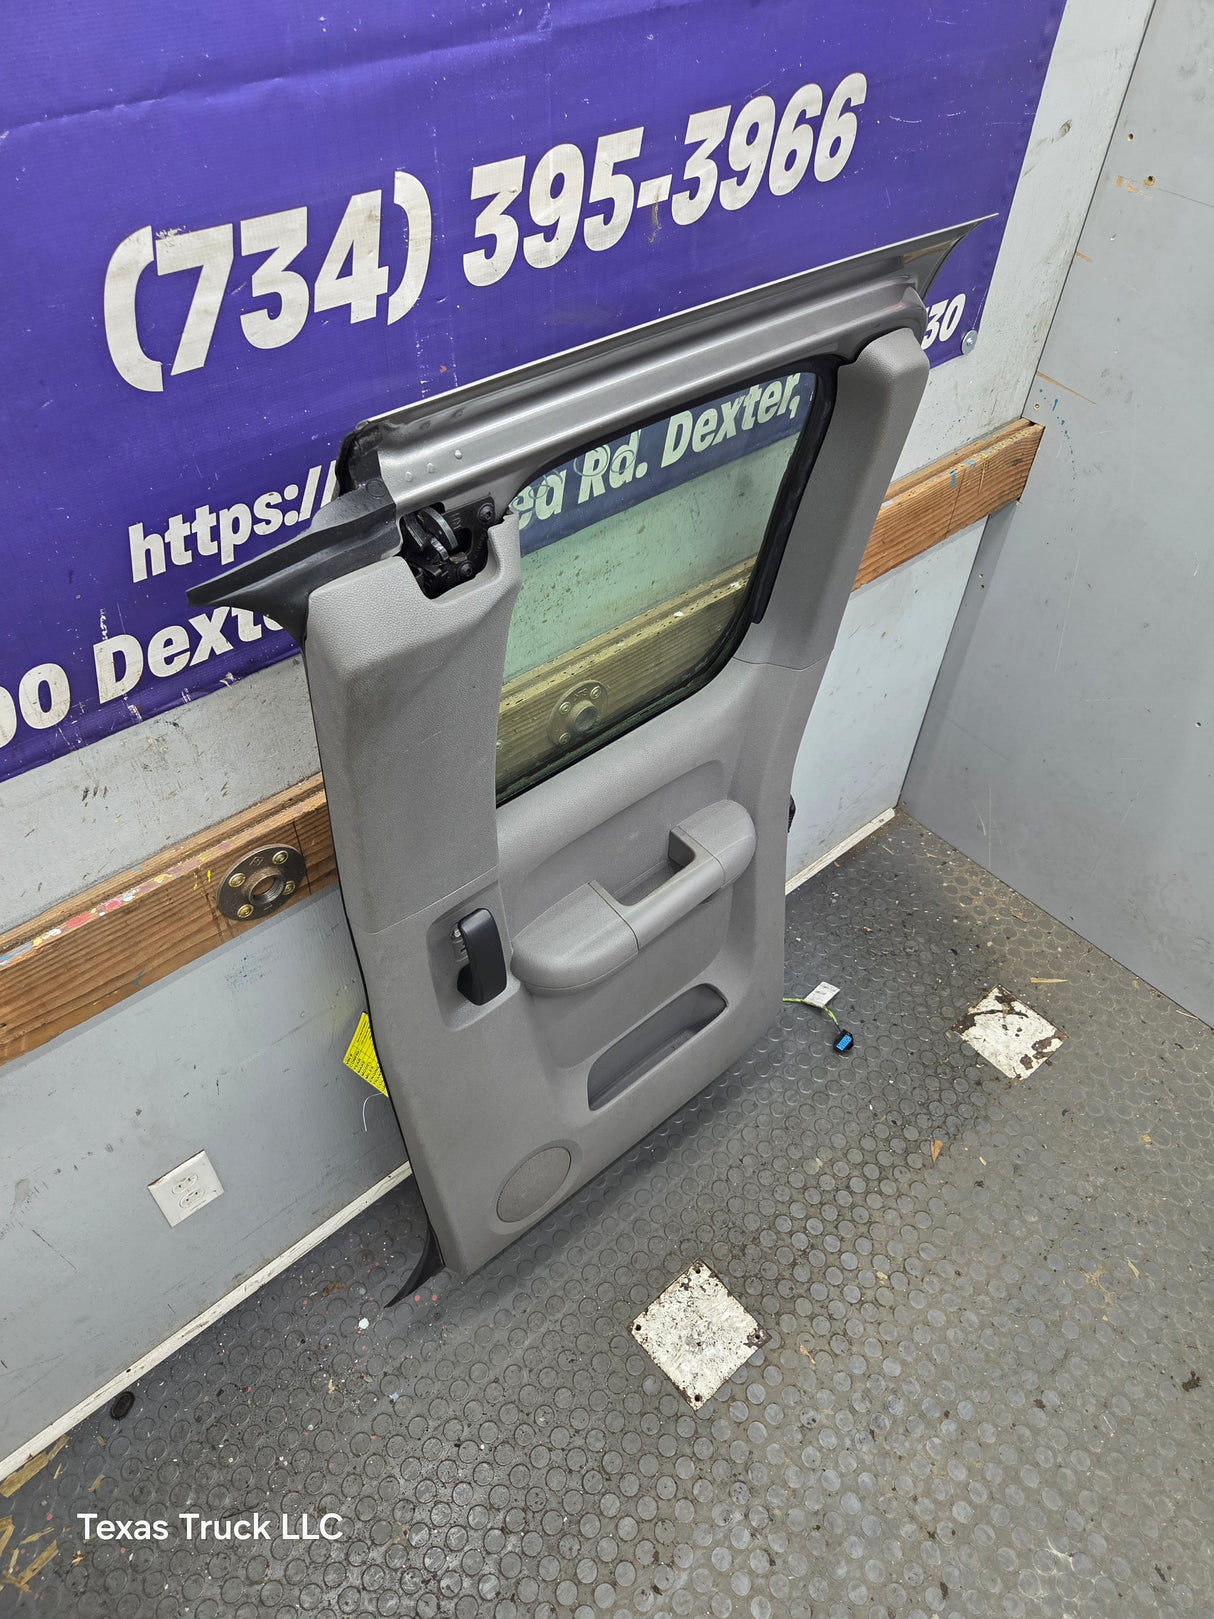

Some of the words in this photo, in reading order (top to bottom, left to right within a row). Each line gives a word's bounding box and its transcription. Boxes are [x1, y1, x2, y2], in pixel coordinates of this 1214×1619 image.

[104, 171, 432, 392] (734)
[463, 72, 867, 287] 395-3966
[577, 428, 648, 504] Rd.
[660, 372, 801, 468] Dexter,
[921, 293, 966, 350] 30
